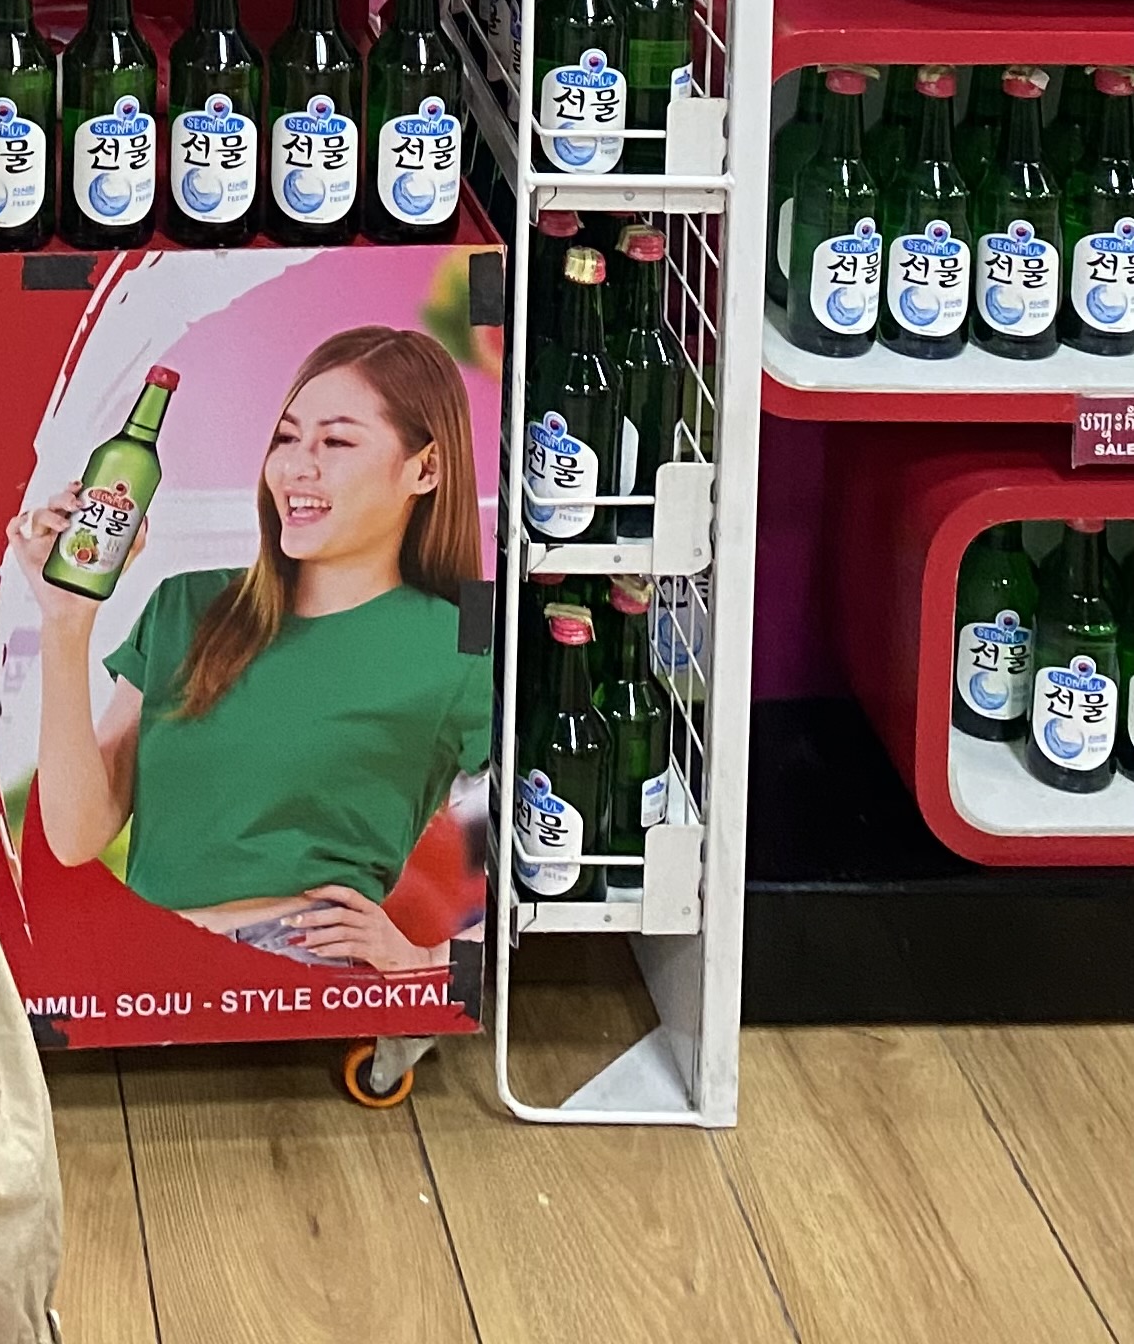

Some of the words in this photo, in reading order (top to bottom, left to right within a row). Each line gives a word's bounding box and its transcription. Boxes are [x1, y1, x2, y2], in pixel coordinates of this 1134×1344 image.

[562, 72, 614, 86] SEONMUL
[553, 86, 620, 122] 선물
[187, 117, 241, 132] SEONMUL
[288, 117, 343, 133] SEONMUL
[399, 120, 451, 134] SEONMUL
[87, 134, 152, 171] 선물
[181, 132, 248, 170] 선물
[282, 133, 350, 170] 선물
[391, 134, 456, 171] 선물
[985, 252, 1050, 288] 선물
[116, 991, 193, 1017] SOJU
[221, 988, 312, 1013] STYLE
[322, 982, 464, 1010] COCKTAI
